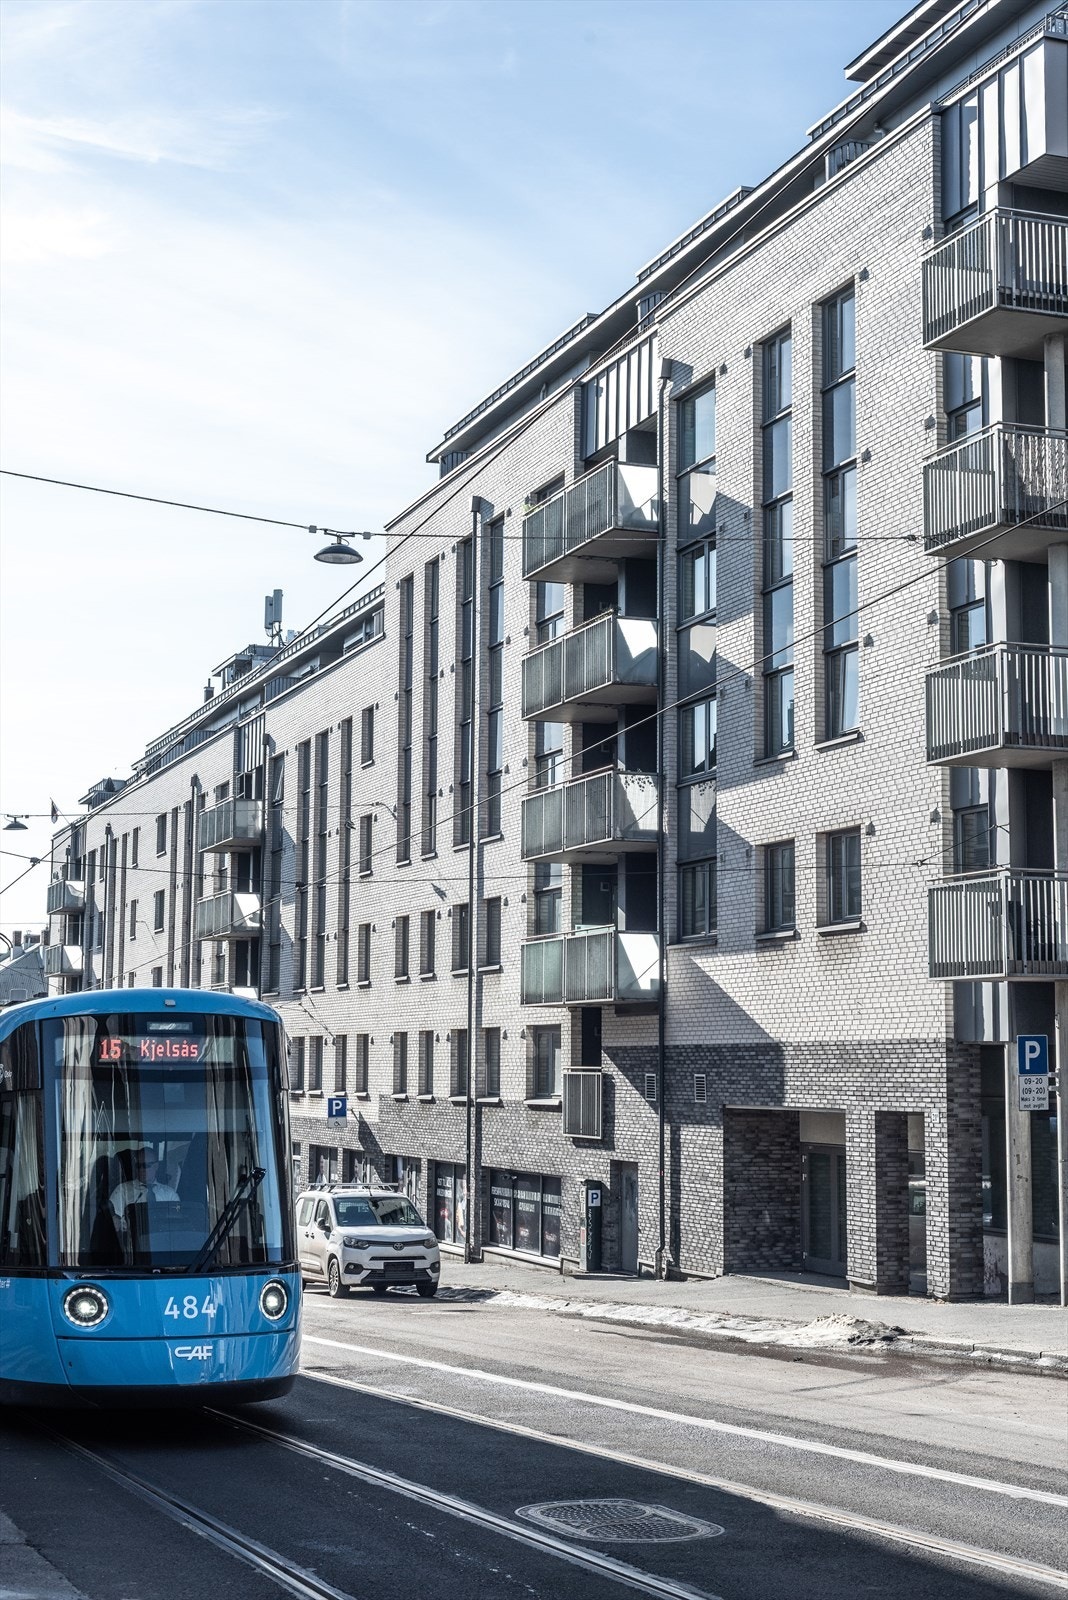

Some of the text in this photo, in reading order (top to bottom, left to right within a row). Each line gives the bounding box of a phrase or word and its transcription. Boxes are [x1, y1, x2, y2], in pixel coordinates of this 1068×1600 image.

[100, 1039, 198, 1061] 15 Kjelsås
[1025, 1041, 1040, 1069] P
[333, 1100, 342, 1115] P
[591, 1193, 598, 1204] P
[164, 1295, 217, 1319] 484
[174, 1345, 213, 1361] CAF
